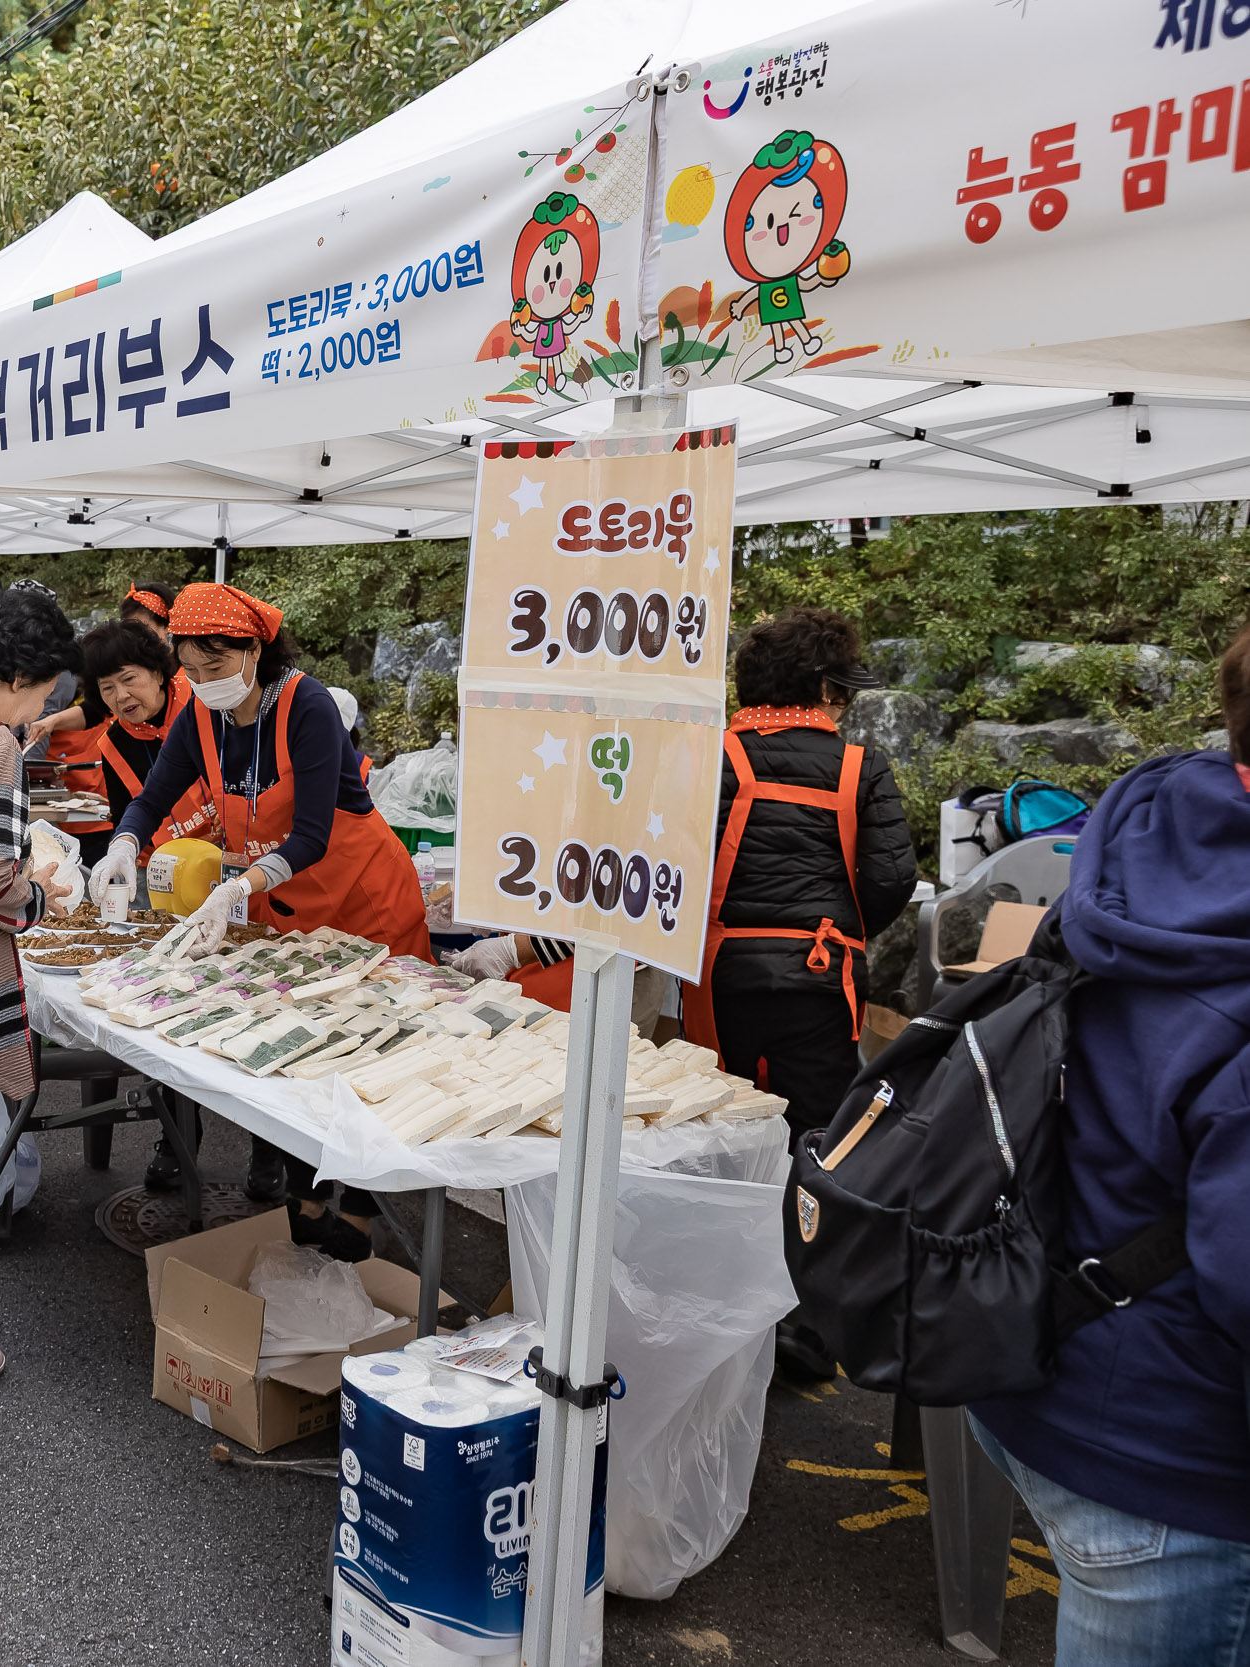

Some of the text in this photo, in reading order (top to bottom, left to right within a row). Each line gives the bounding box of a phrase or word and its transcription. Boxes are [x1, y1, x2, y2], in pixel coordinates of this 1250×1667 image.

[755, 60, 828, 106] 행복광진
[757, 42, 830, 77] 소통하며 발전하는
[956, 122, 1082, 244] 능동
[267, 281, 352, 338] 도토리묵
[367, 240, 485, 312] 3,000원
[261, 349, 282, 384] 떡
[298, 319, 401, 381] 2,000원
[557, 492, 693, 564] 도토리묵
[511, 590, 707, 664] 3,000원
[591, 737, 630, 799] 떡
[498, 836, 683, 931] 2,000원
[203, 1304, 209, 1315] 2
[466, 1449, 493, 1464] SINCE 1974
